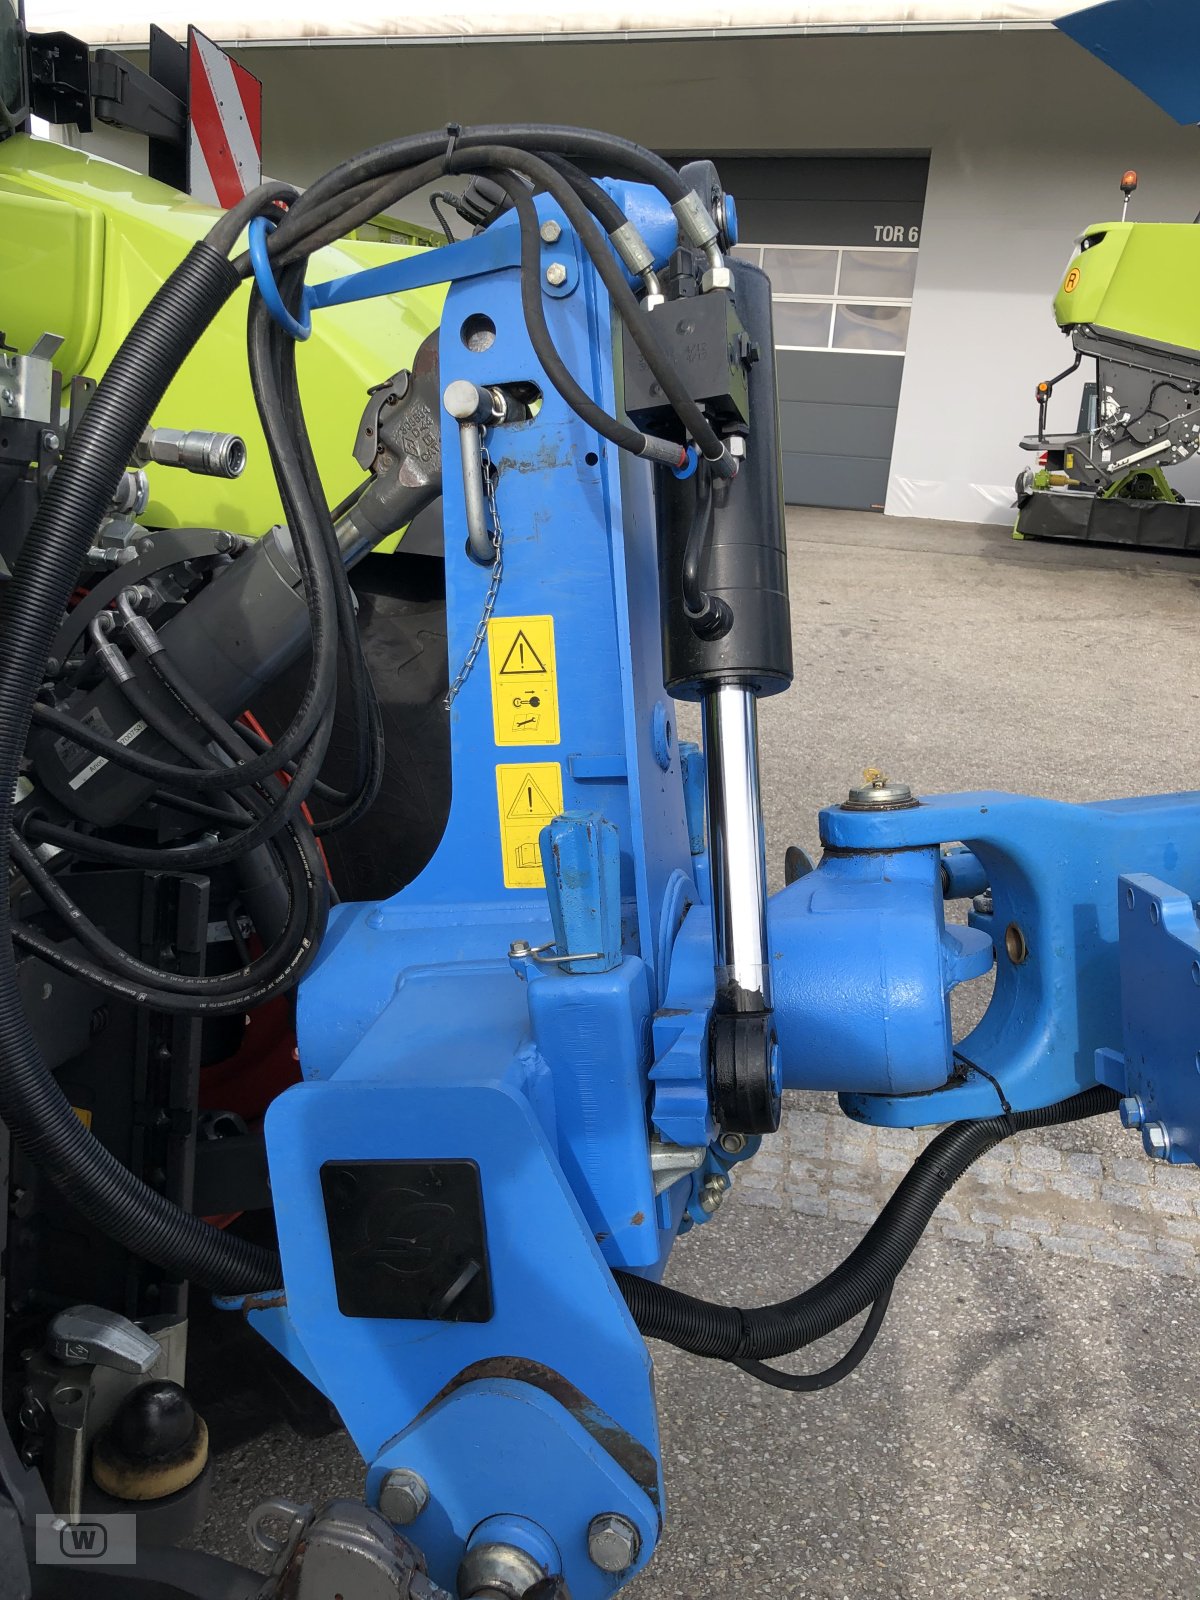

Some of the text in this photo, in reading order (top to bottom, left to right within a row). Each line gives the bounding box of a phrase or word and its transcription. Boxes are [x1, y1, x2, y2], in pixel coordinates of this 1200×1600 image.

[873, 225, 919, 242] TOR 6
[1066, 272, 1077, 288] R
